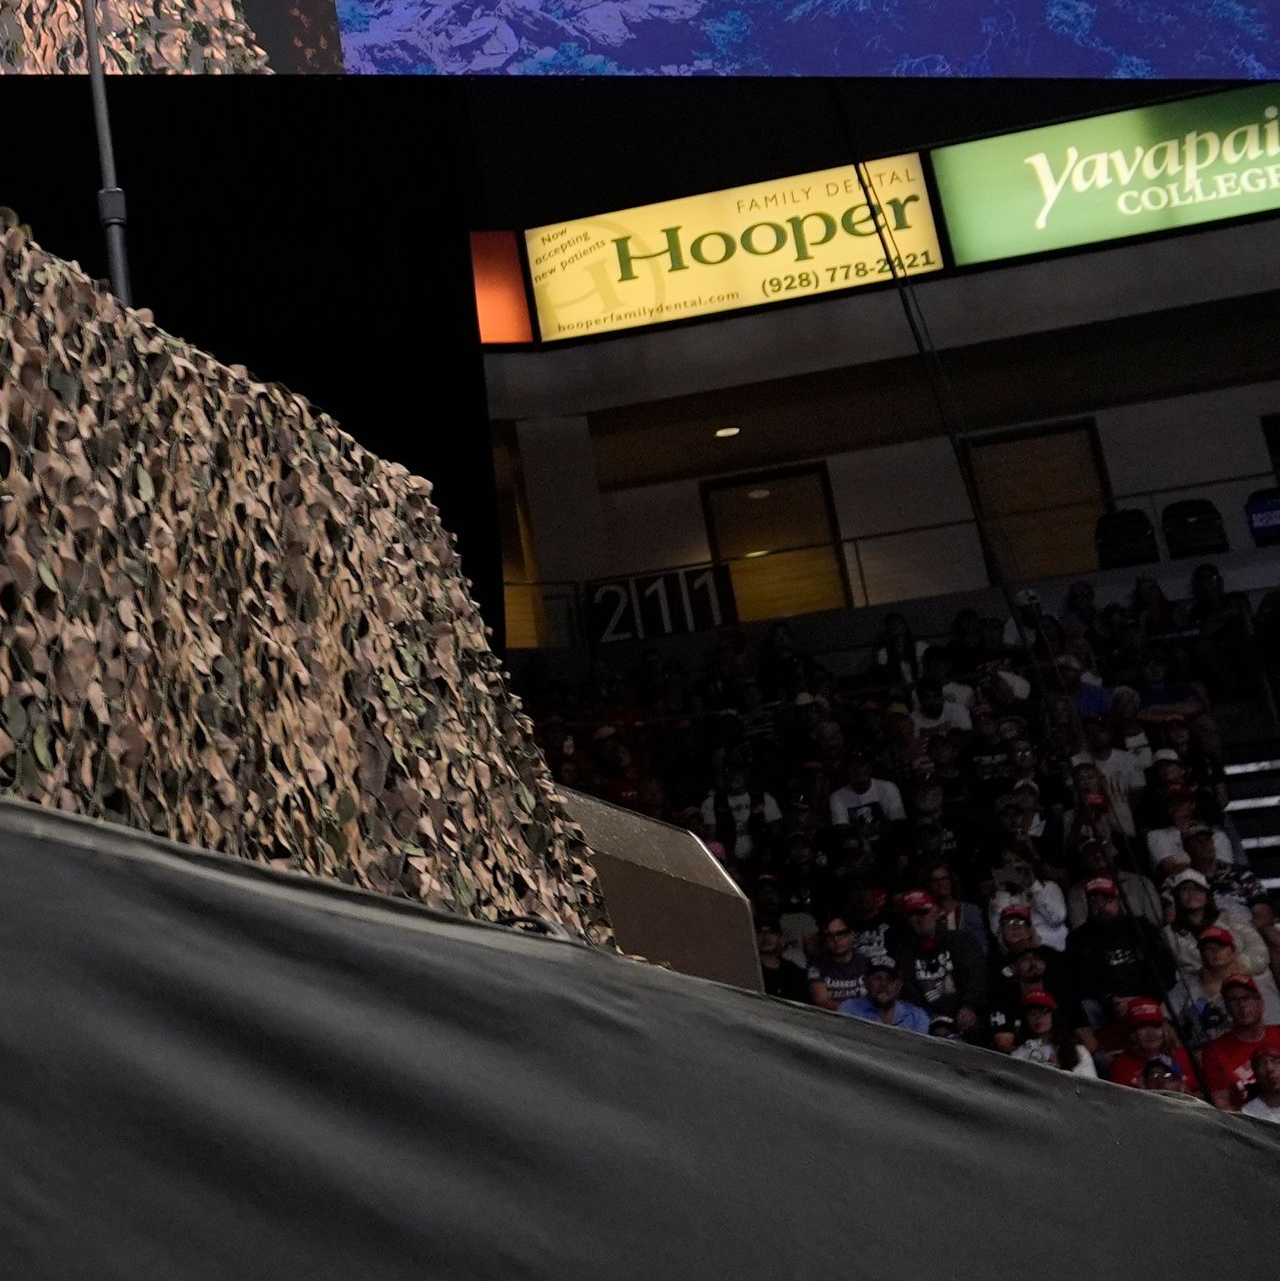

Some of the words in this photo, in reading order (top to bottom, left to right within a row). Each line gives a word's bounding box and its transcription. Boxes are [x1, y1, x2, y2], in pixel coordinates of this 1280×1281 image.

[736, 185, 813, 214] FAMILY
[535, 230, 591, 266] accepting
[541, 226, 569, 247] Now
[611, 193, 920, 283] Hooper
[534, 267, 558, 284] new
[560, 239, 607, 272] patients
[761, 270, 820, 298] (928)
[557, 291, 740, 333] hooperfamilydental.com
